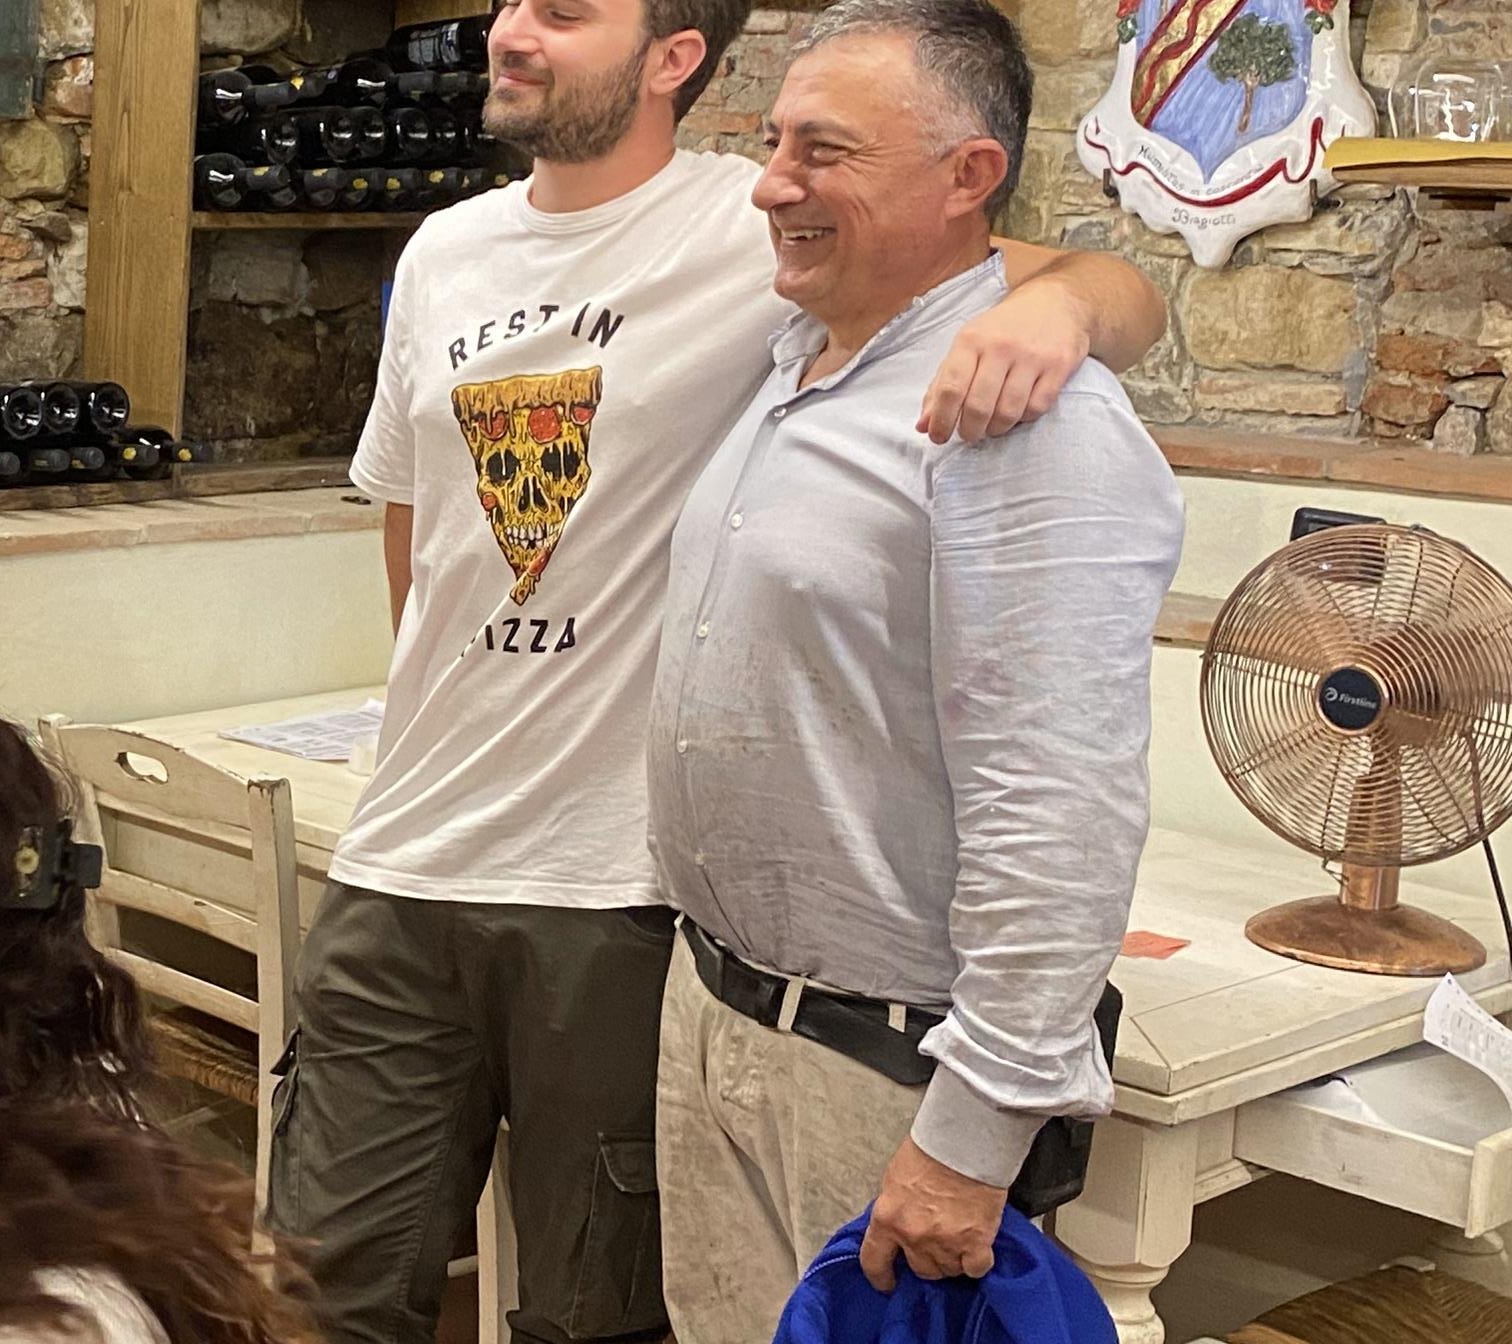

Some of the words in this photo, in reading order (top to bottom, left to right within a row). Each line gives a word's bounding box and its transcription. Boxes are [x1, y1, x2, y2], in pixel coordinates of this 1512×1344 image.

[1171, 207, 1237, 230] Biagiotti
[448, 304, 560, 371] REST
[571, 302, 625, 349] IN
[461, 616, 576, 657] IZZA
